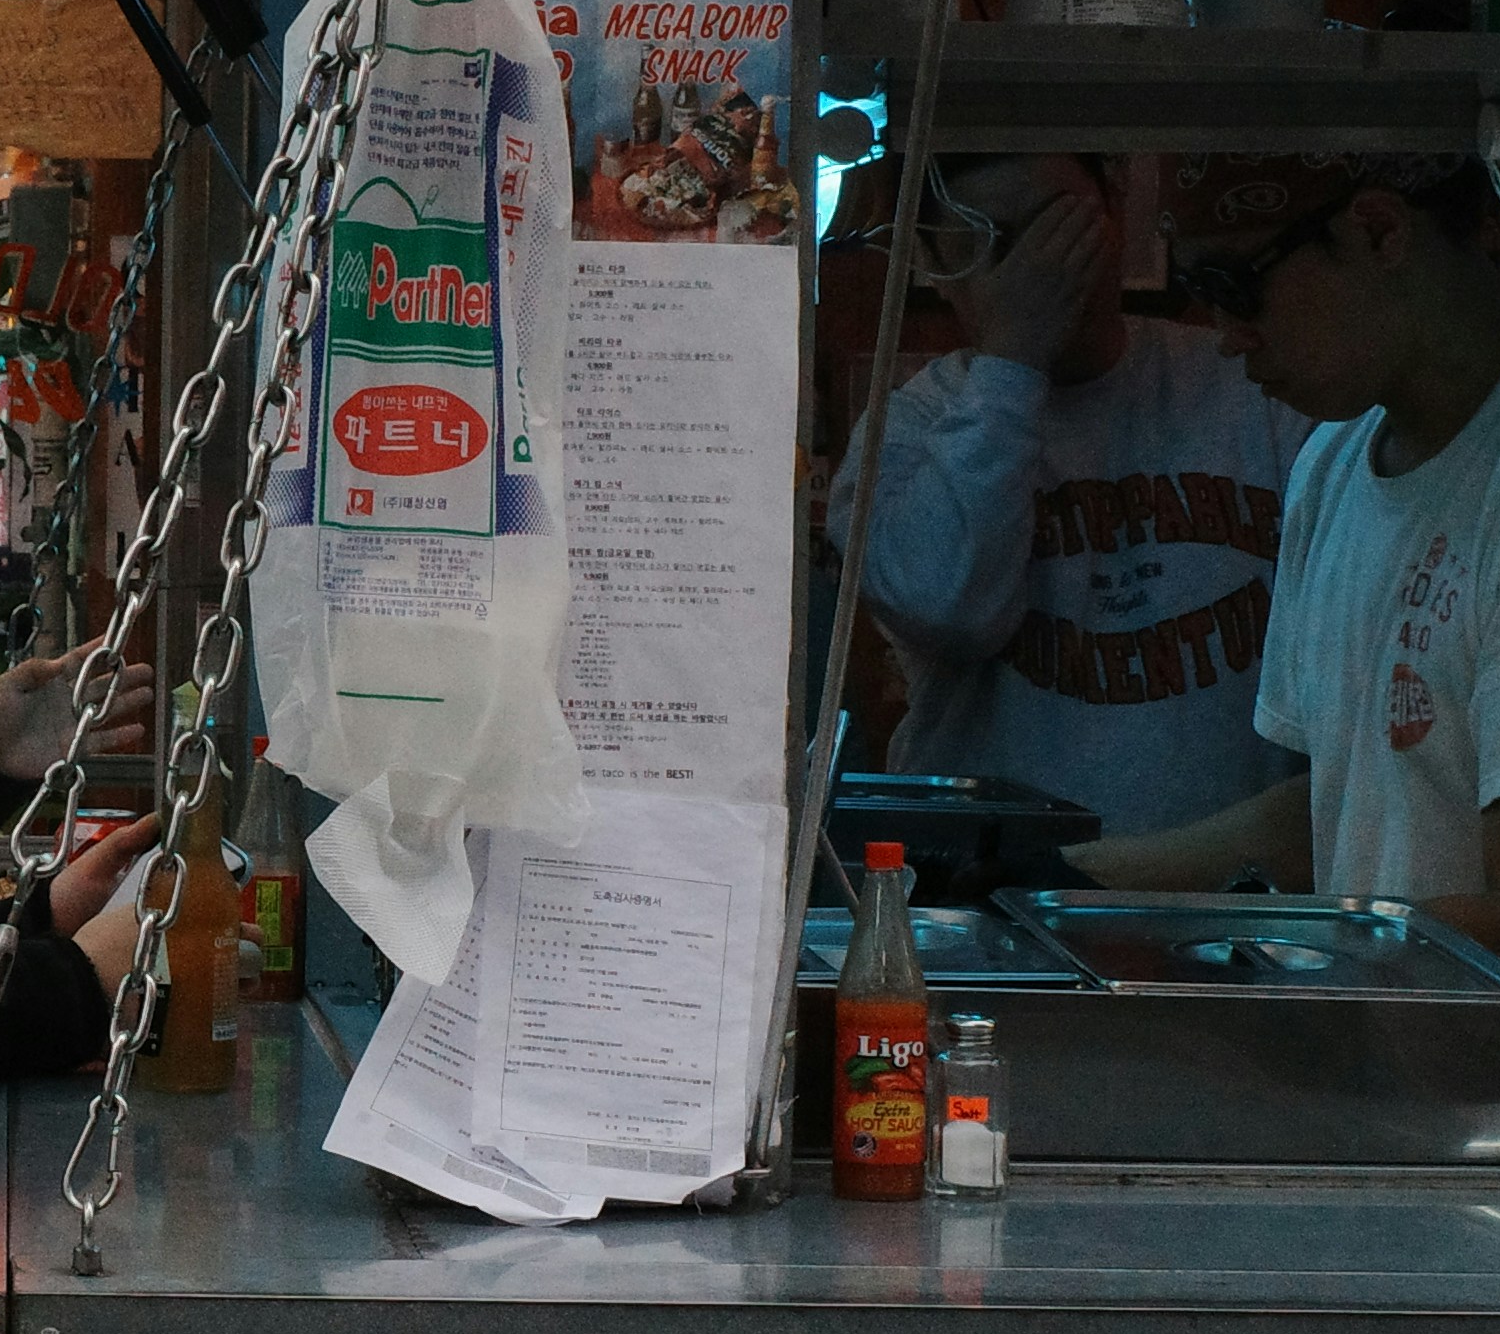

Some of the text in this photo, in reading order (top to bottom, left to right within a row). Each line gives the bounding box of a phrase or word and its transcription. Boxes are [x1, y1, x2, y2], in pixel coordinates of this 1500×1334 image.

[604, 3, 789, 41] MEGA BOMB
[642, 48, 749, 86] SNACK
[344, 414, 470, 458] 파트너
[602, 769, 625, 778] taco
[665, 769, 694, 779] BEST!
[857, 1035, 925, 1068] Ligo
[852, 1117, 884, 1131] HOT
[873, 1101, 911, 1117] Extra
